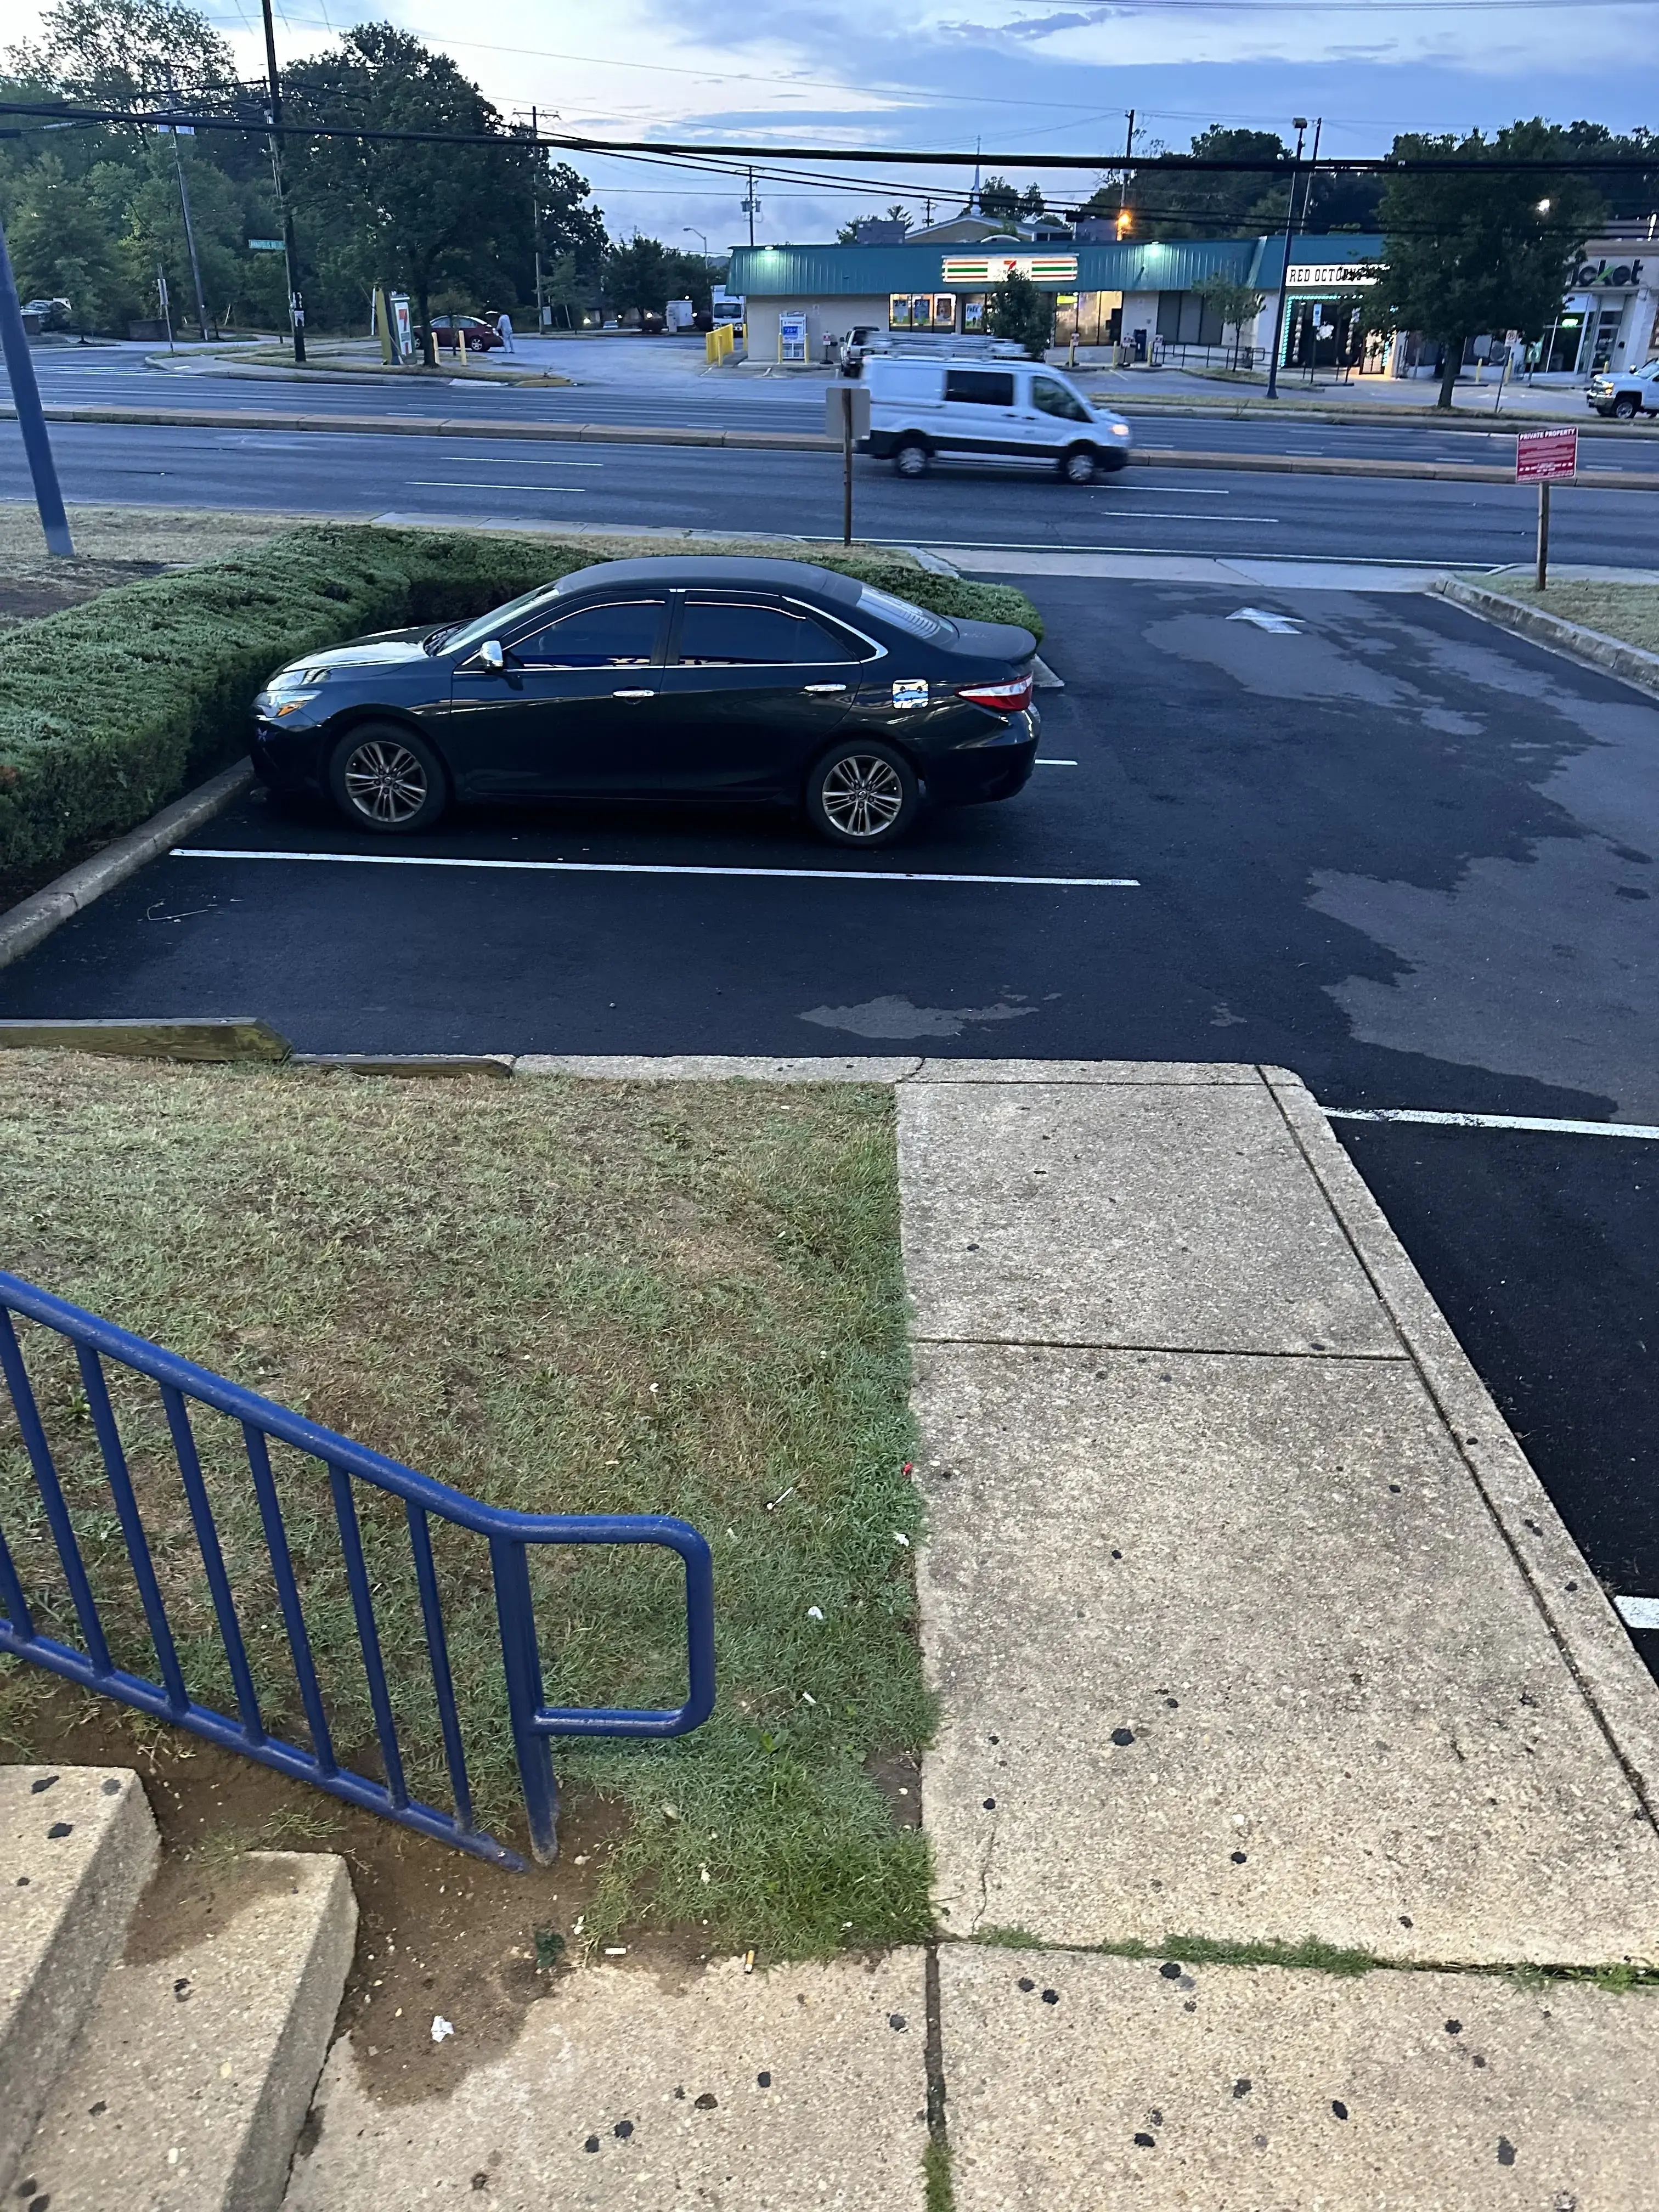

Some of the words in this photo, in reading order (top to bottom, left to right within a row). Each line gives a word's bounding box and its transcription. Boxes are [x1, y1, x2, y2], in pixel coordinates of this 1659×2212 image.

[1289, 269, 1311, 283] RED
[1520, 431, 1544, 441] PRIVATE
[1545, 428, 1575, 437] PROPERTY
